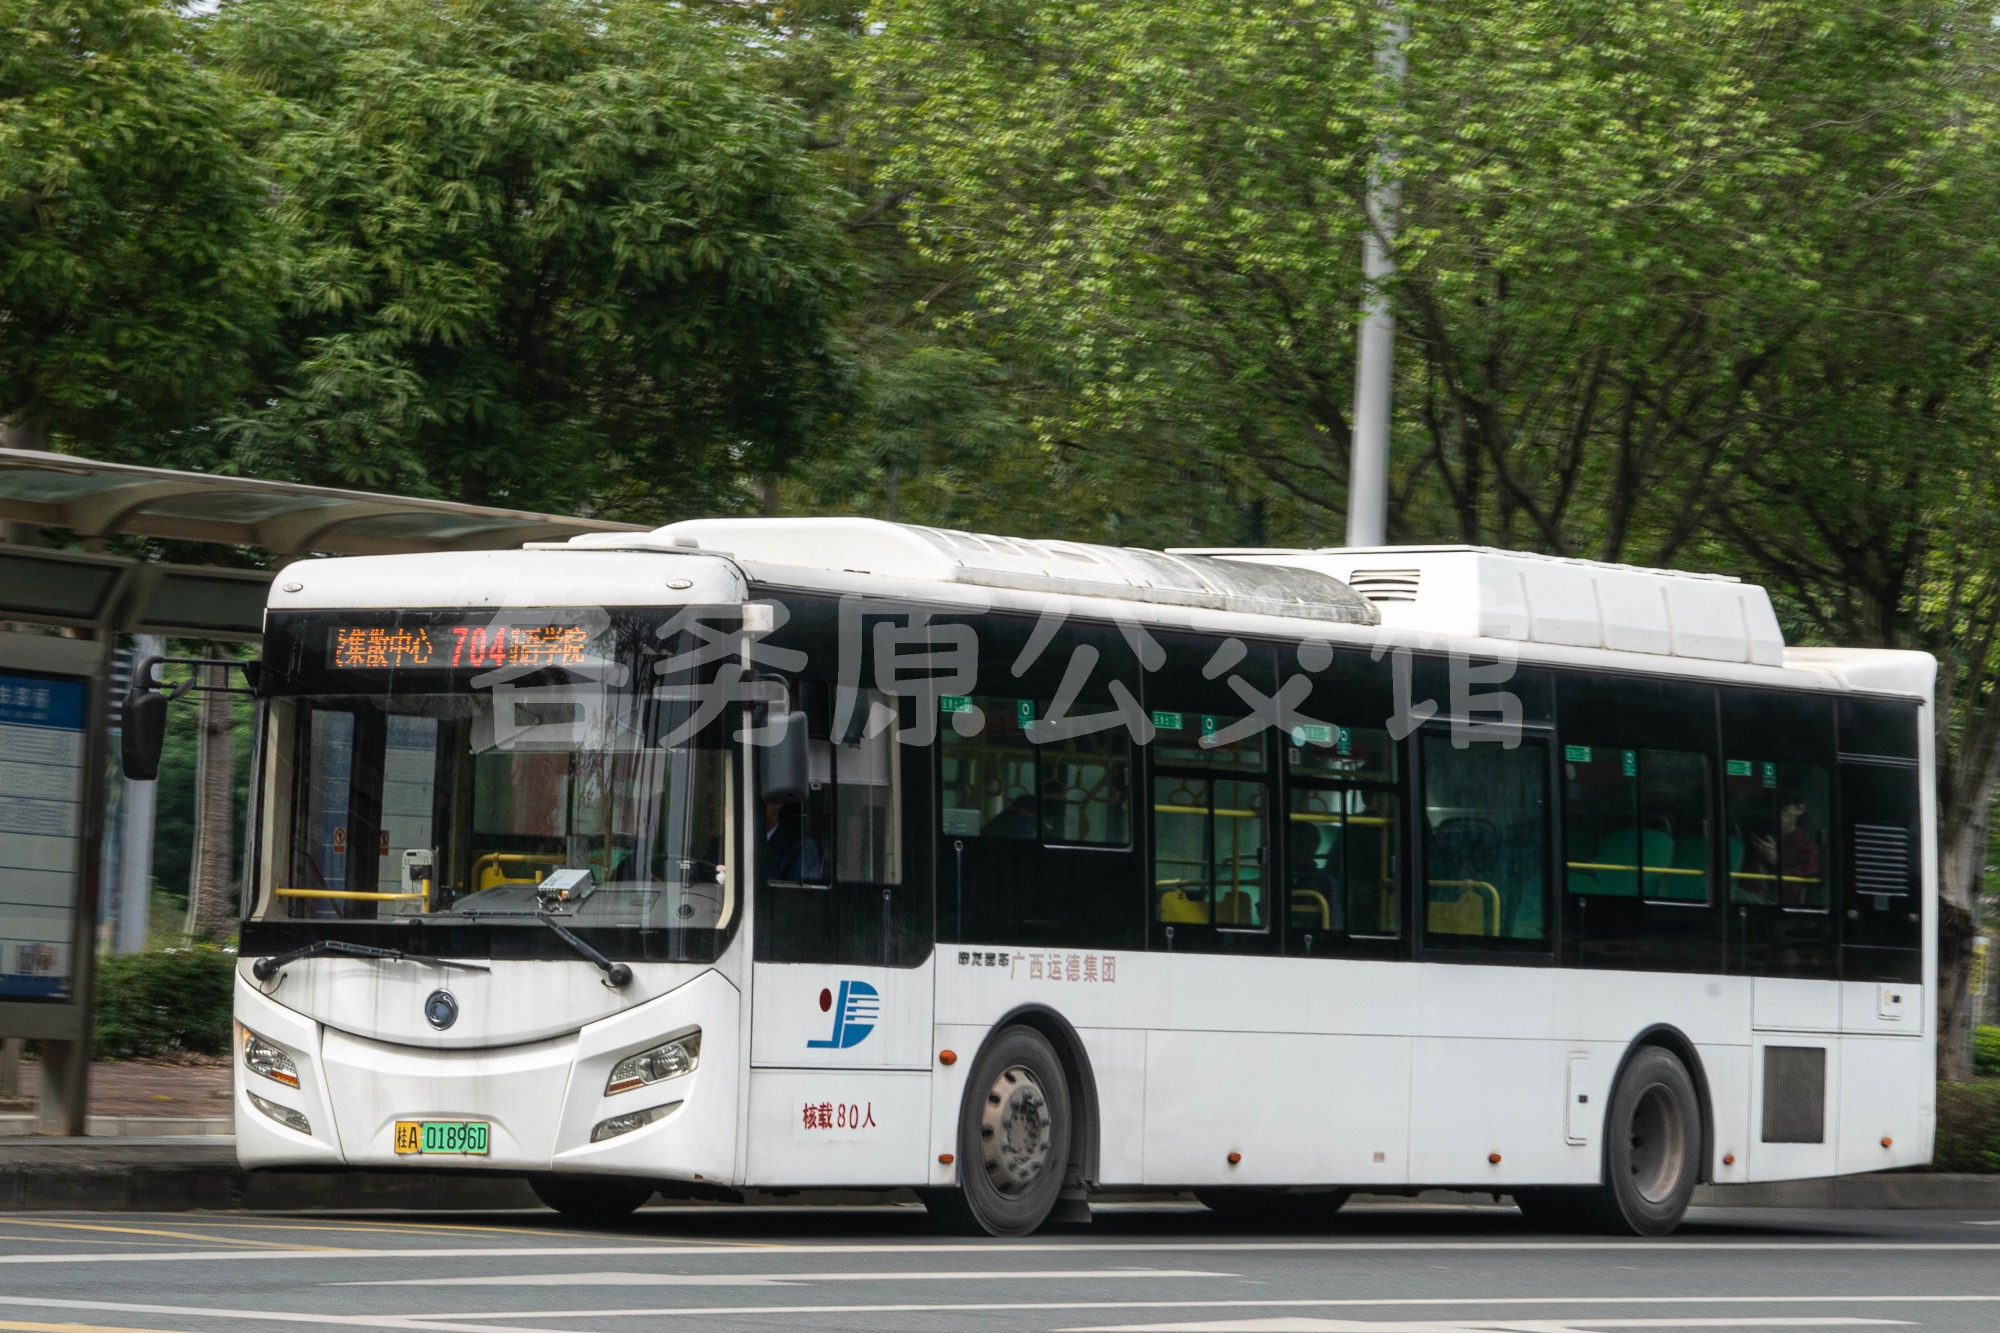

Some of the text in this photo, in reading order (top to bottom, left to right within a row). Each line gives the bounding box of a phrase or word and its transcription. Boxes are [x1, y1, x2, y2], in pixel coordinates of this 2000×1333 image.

[452, 627, 507, 667] 704
[1010, 951, 1116, 983] 广西运德集团
